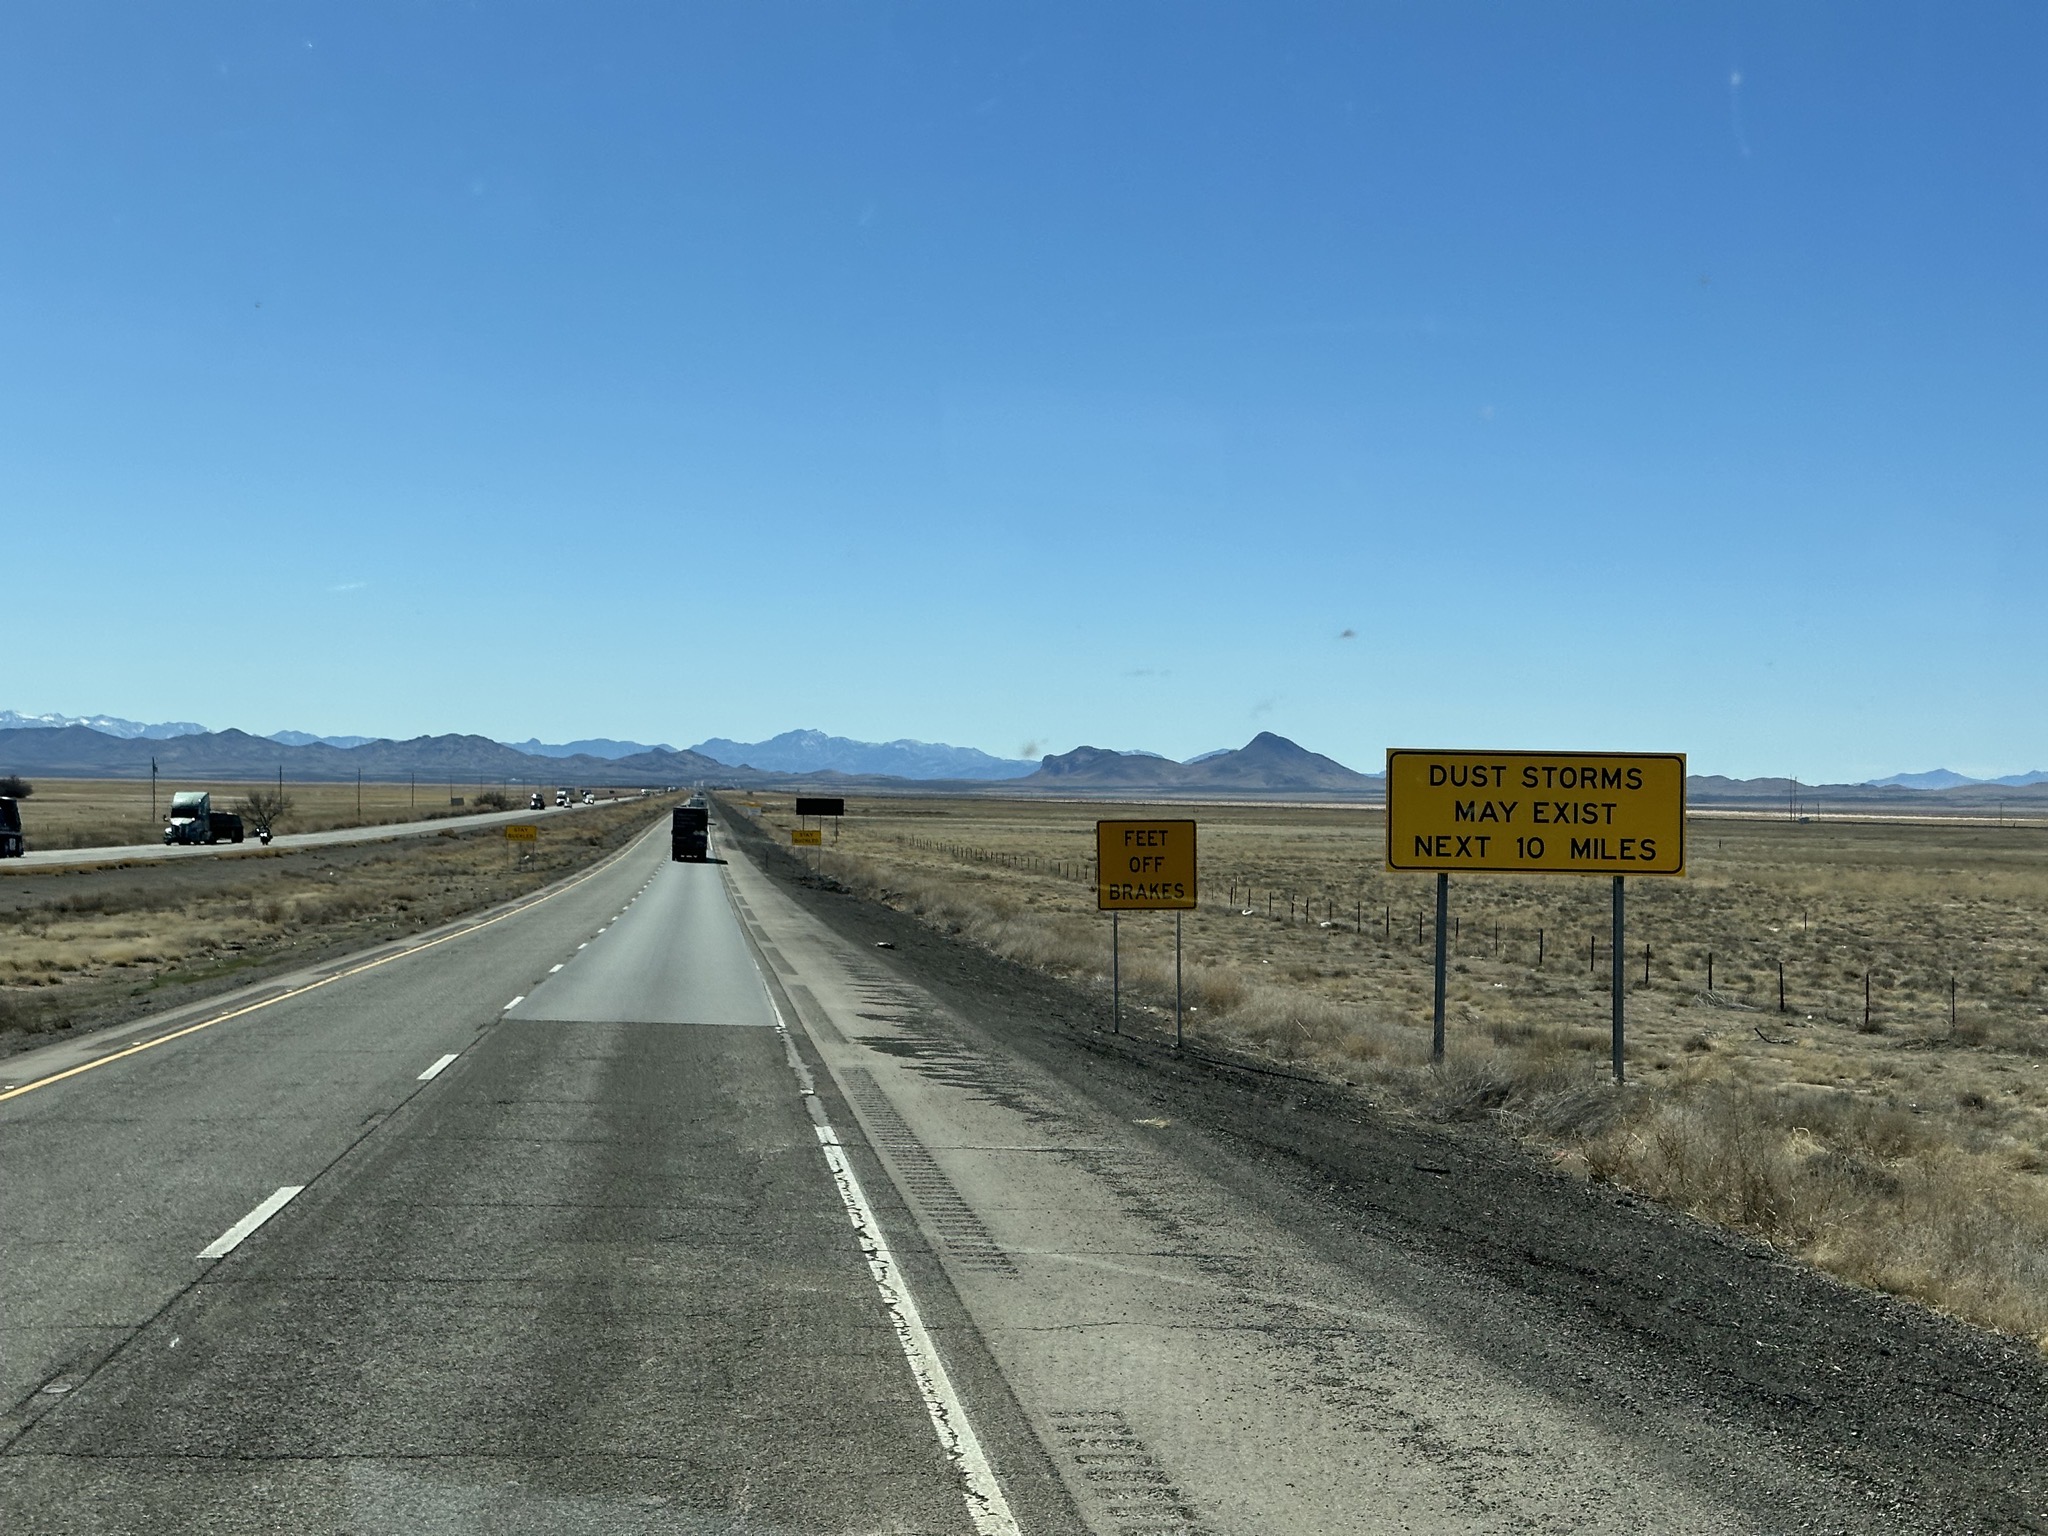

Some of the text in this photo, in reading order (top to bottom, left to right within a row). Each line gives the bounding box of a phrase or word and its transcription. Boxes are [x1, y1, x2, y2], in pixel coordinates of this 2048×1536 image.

[1430, 765, 1643, 790] DUST STORMS
[1455, 801, 1617, 824] MAY EXIST
[1124, 830, 1168, 846] FEET
[1414, 835, 1657, 861] NEXT 10 MILES
[1129, 856, 1165, 873] OFF
[1109, 883, 1185, 900] BRAKES
